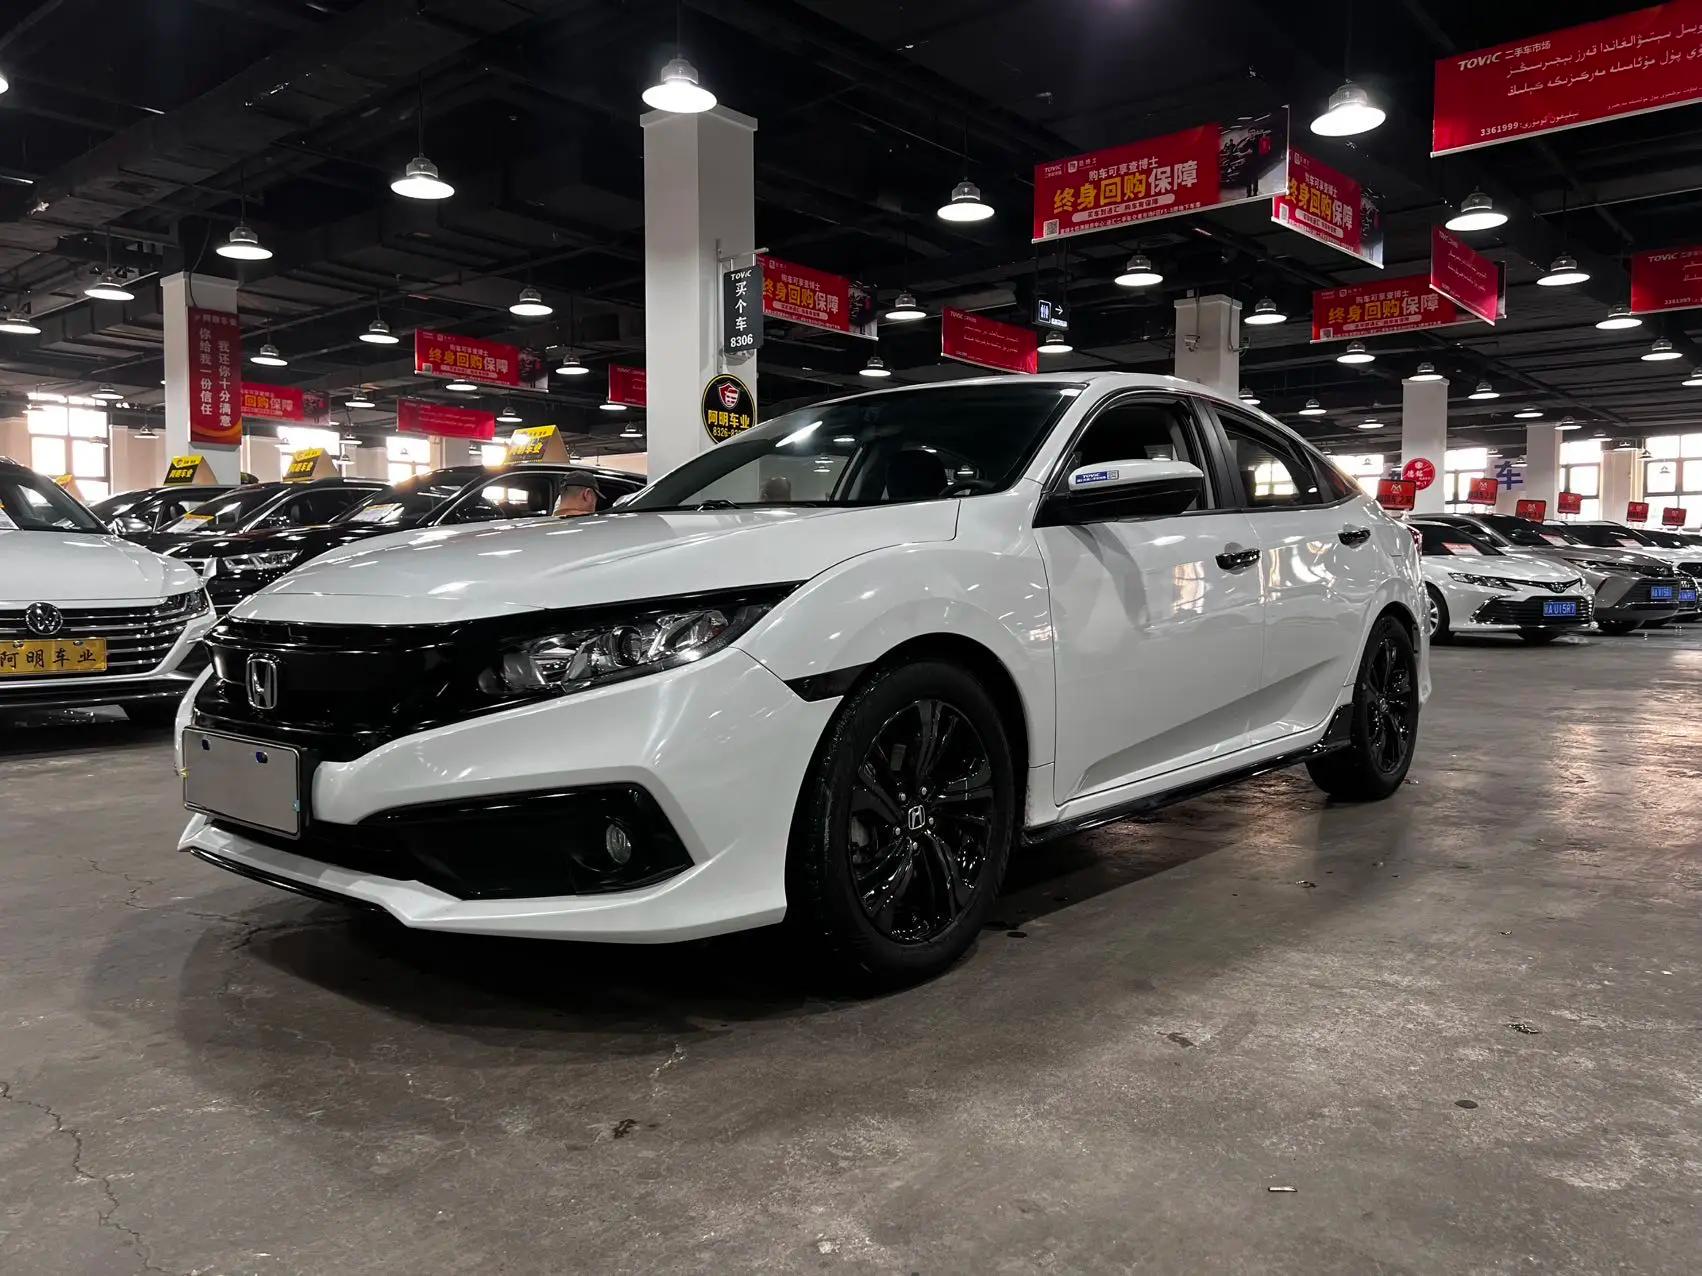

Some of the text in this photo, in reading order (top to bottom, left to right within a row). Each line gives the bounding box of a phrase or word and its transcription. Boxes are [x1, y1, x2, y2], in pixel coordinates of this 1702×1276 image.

[1505, 40, 1552, 60] 二手车市场
[1480, 122, 1519, 136] 3361999
[1088, 156, 1159, 182] 购车可享查博士
[1053, 160, 1199, 214] 终身回购保障
[1285, 177, 1353, 231] 终身回购保障
[734, 281, 748, 331] 买个车
[1328, 293, 1440, 324] 终身回购保障
[730, 334, 754, 347] 8306
[200, 327, 213, 415] 你给我一份信任
[428, 347, 509, 374] 终身回购保障
[218, 340, 232, 427] 我还你十分满意
[708, 411, 750, 429] 阿明车业
[1494, 461, 1523, 490] 车
[0, 647, 97, 669] 阿明车业
